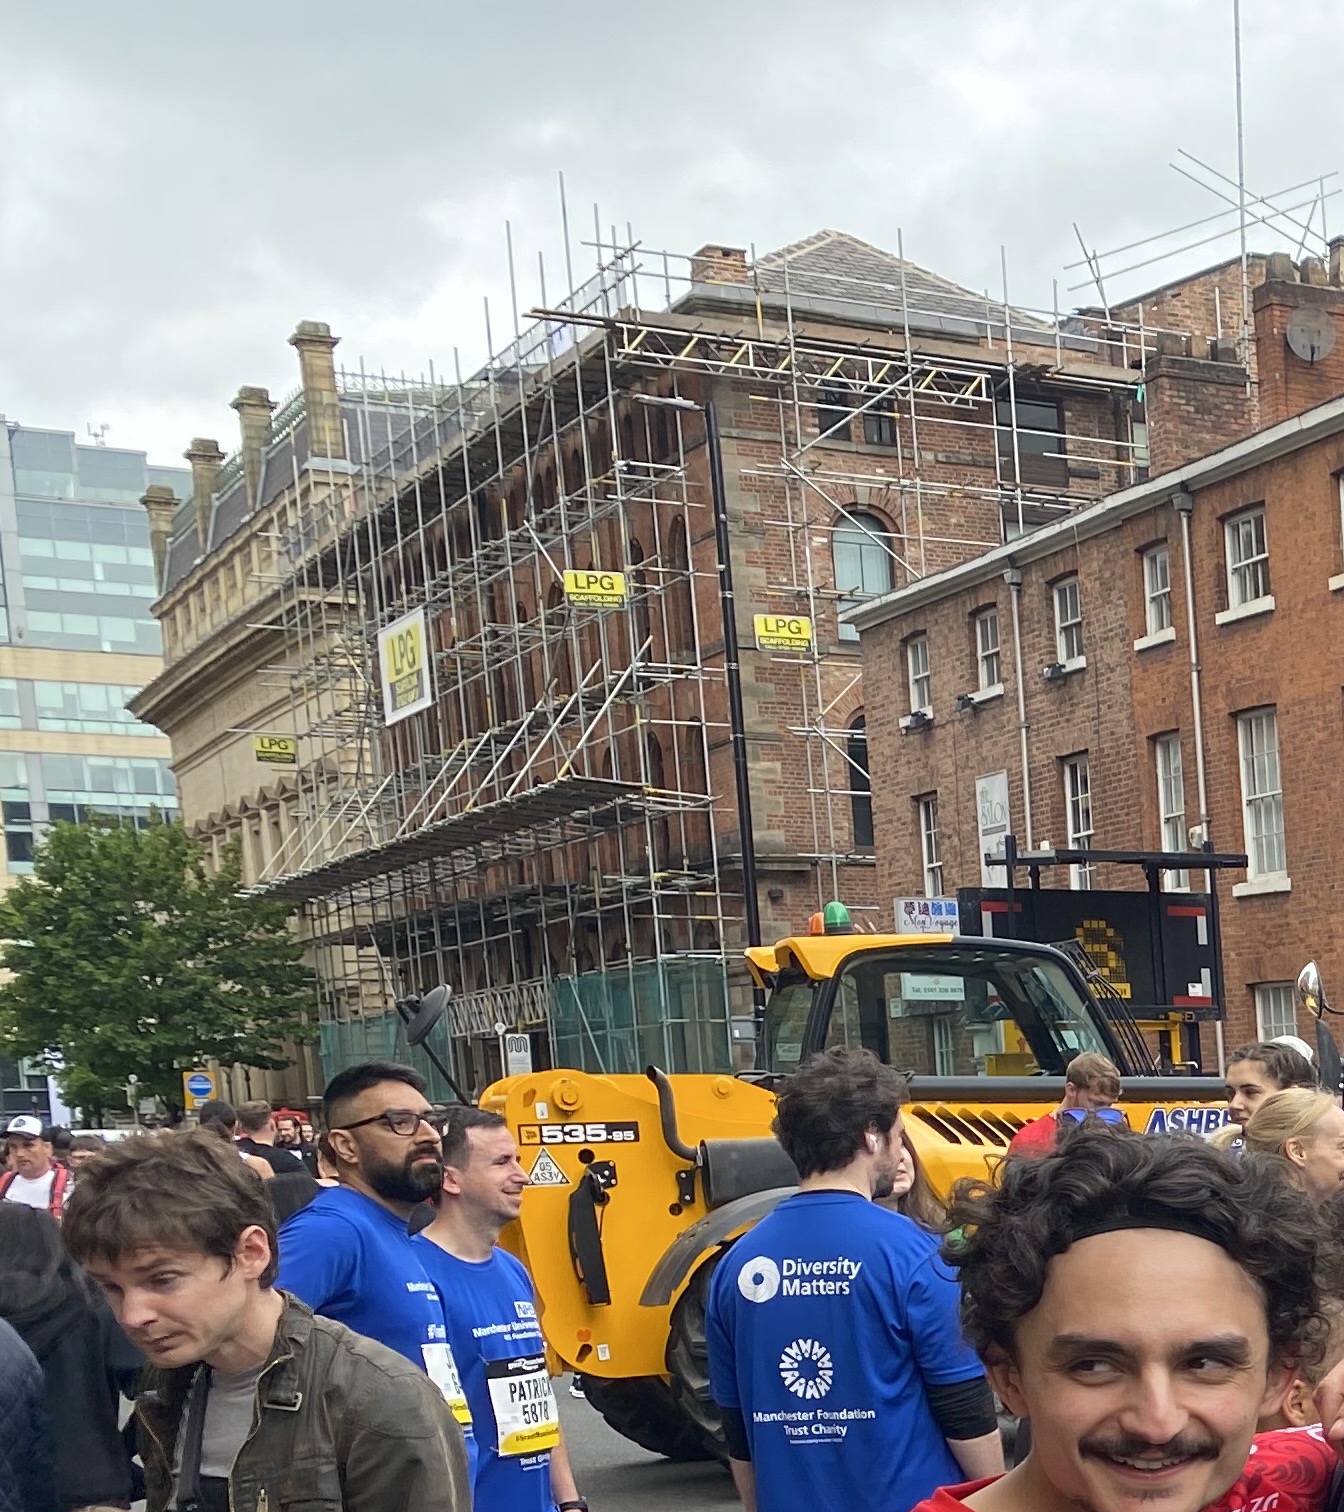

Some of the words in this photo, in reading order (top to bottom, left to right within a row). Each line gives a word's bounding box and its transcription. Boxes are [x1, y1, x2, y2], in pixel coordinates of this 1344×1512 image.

[573, 573, 615, 590] LPG
[764, 617, 802, 635] LPG
[390, 628, 416, 676] LPG
[260, 738, 288, 751] LPG
[783, 1257, 862, 1279] Diversity
[782, 1279, 850, 1296] Matters
[753, 1410, 814, 1422] Manchester
[816, 1409, 876, 1421] Foundation
[784, 1424, 809, 1435] Trust
[811, 1423, 848, 1436] Charity
